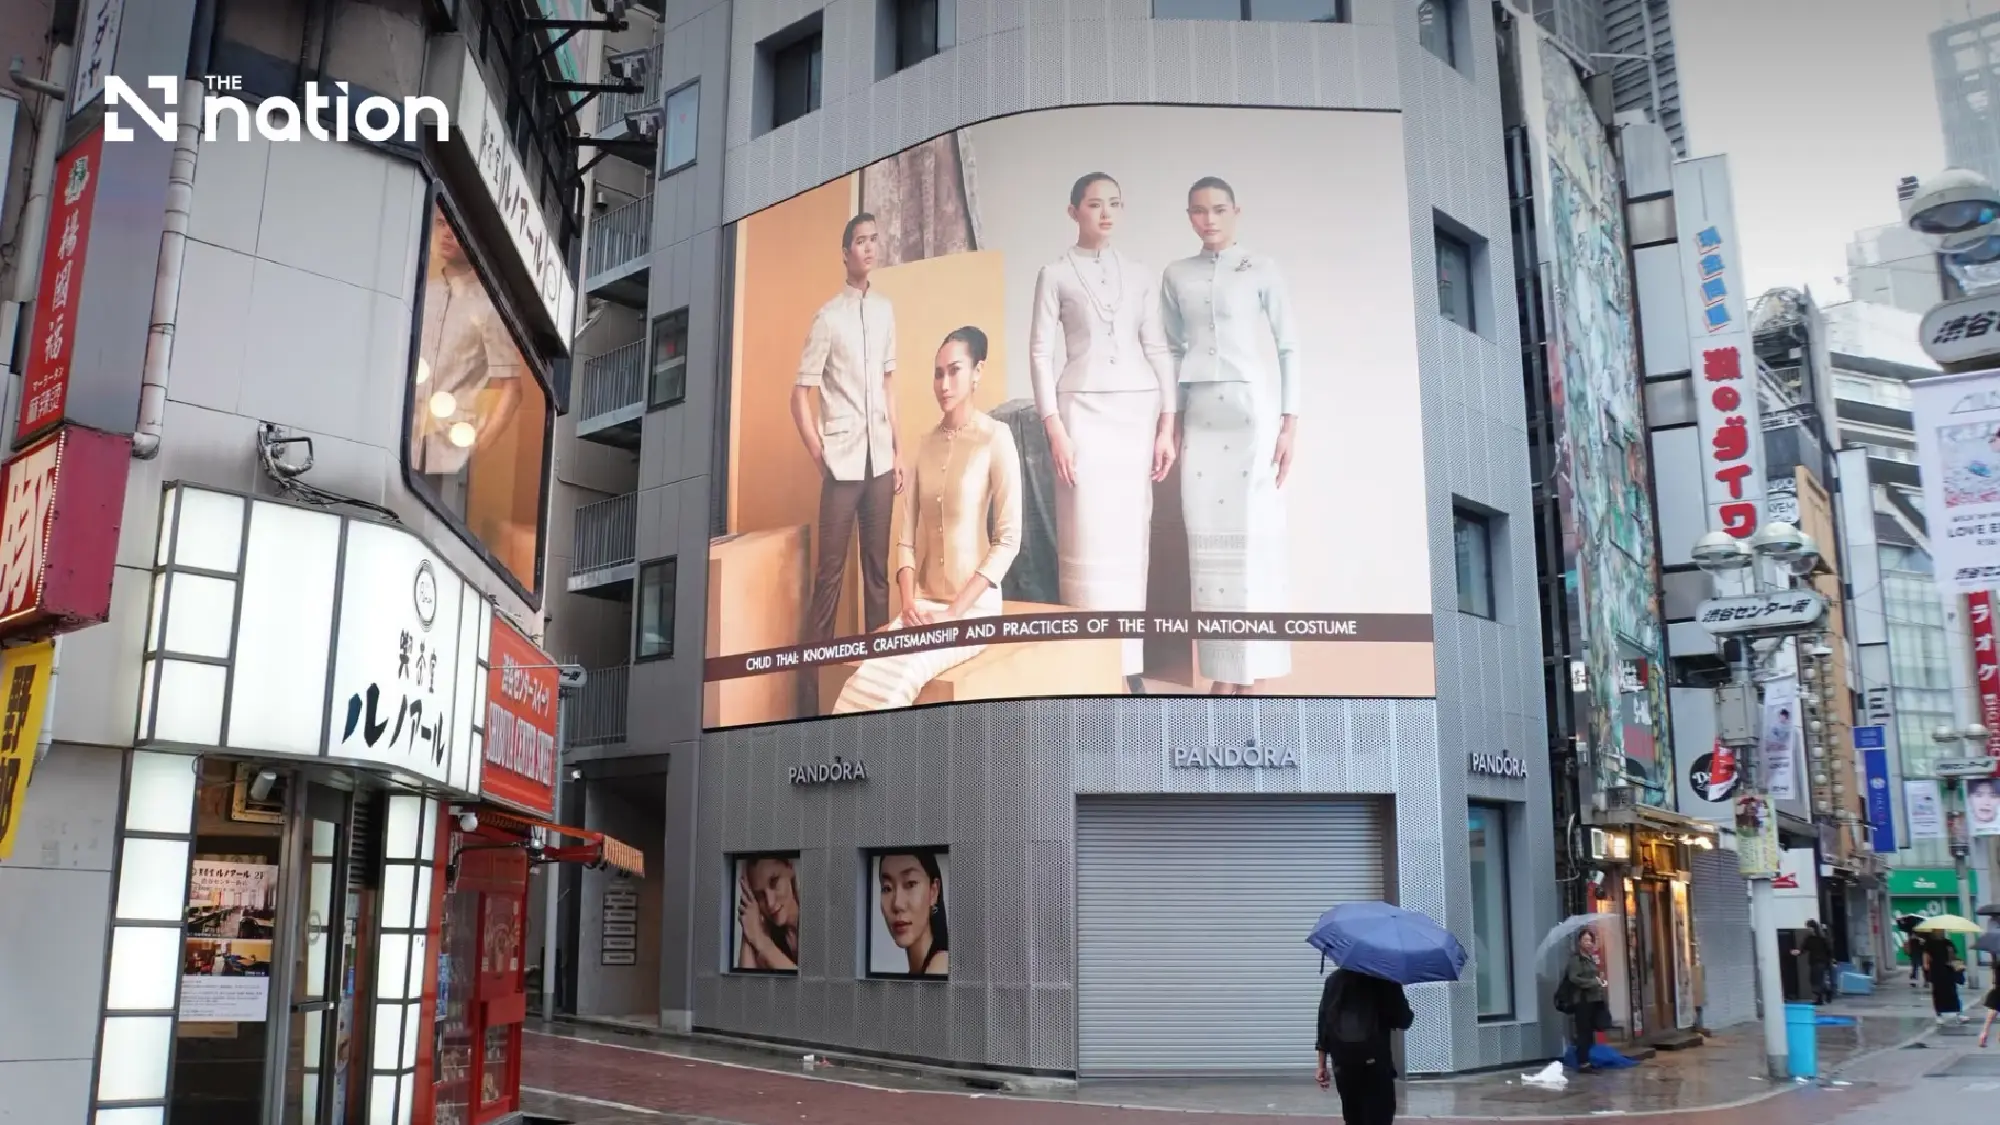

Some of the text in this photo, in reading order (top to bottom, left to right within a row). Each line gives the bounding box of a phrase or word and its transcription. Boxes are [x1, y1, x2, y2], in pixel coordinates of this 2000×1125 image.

[1932, 309, 2000, 345] 渋谷
[1702, 599, 1812, 622] 渋谷センター街
[746, 655, 771, 670] CHUD
[803, 642, 868, 662] KNOWLEDGE,
[873, 625, 959, 652] CRAFTSMANSHIP
[965, 623, 996, 639] AND
[1003, 619, 1078, 637] PRACTICES
[1087, 618, 1110, 633] OF
[1117, 618, 1145, 633] THE
[1154, 618, 1188, 633] THAI
[1197, 619, 1277, 634] NATIONAL
[1285, 619, 1357, 635] COSTUME
[341, 682, 446, 768] ルノアール
[1172, 743, 1299, 768] PANDORA
[1471, 750, 1528, 778] PANDORA
[788, 757, 867, 784] PANDORA
